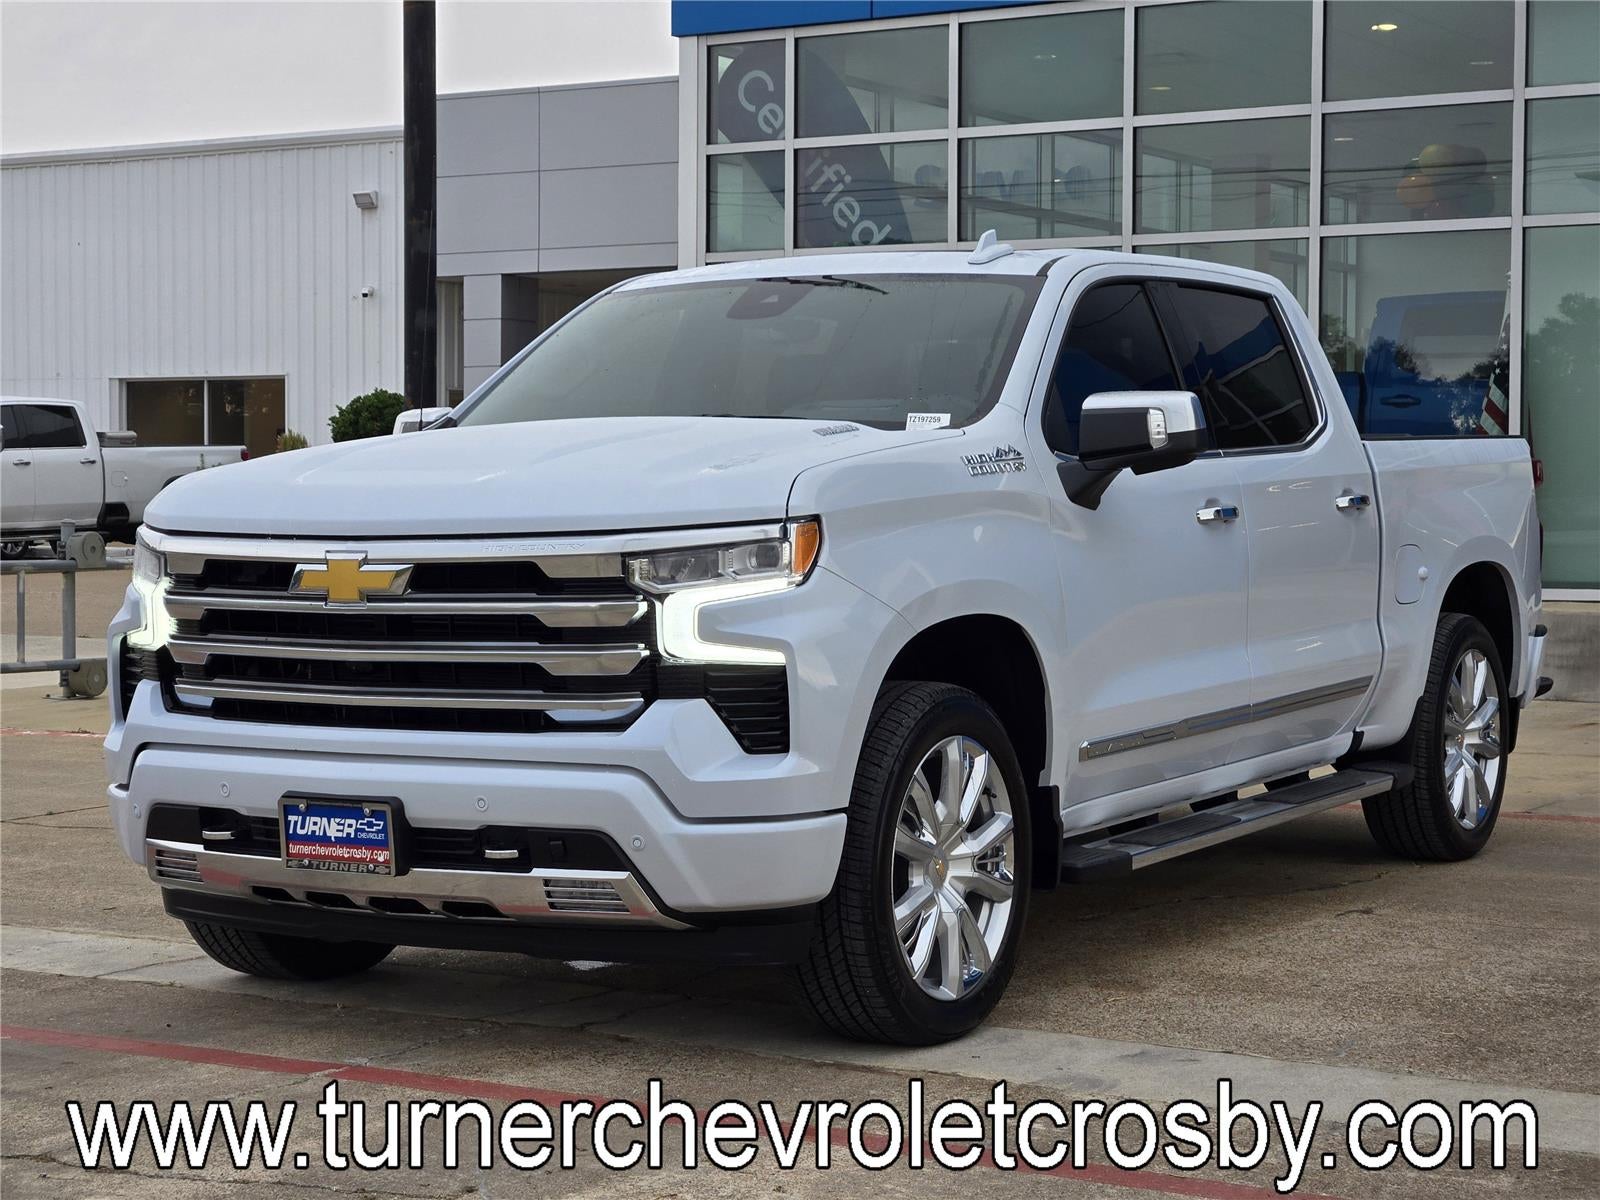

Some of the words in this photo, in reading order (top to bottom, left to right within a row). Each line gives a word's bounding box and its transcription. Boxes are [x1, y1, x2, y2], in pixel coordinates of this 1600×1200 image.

[287, 815, 357, 840] TURNER
[288, 842, 390, 861] turnerchevroletcrosby.com
[311, 861, 367, 872] TURNER
